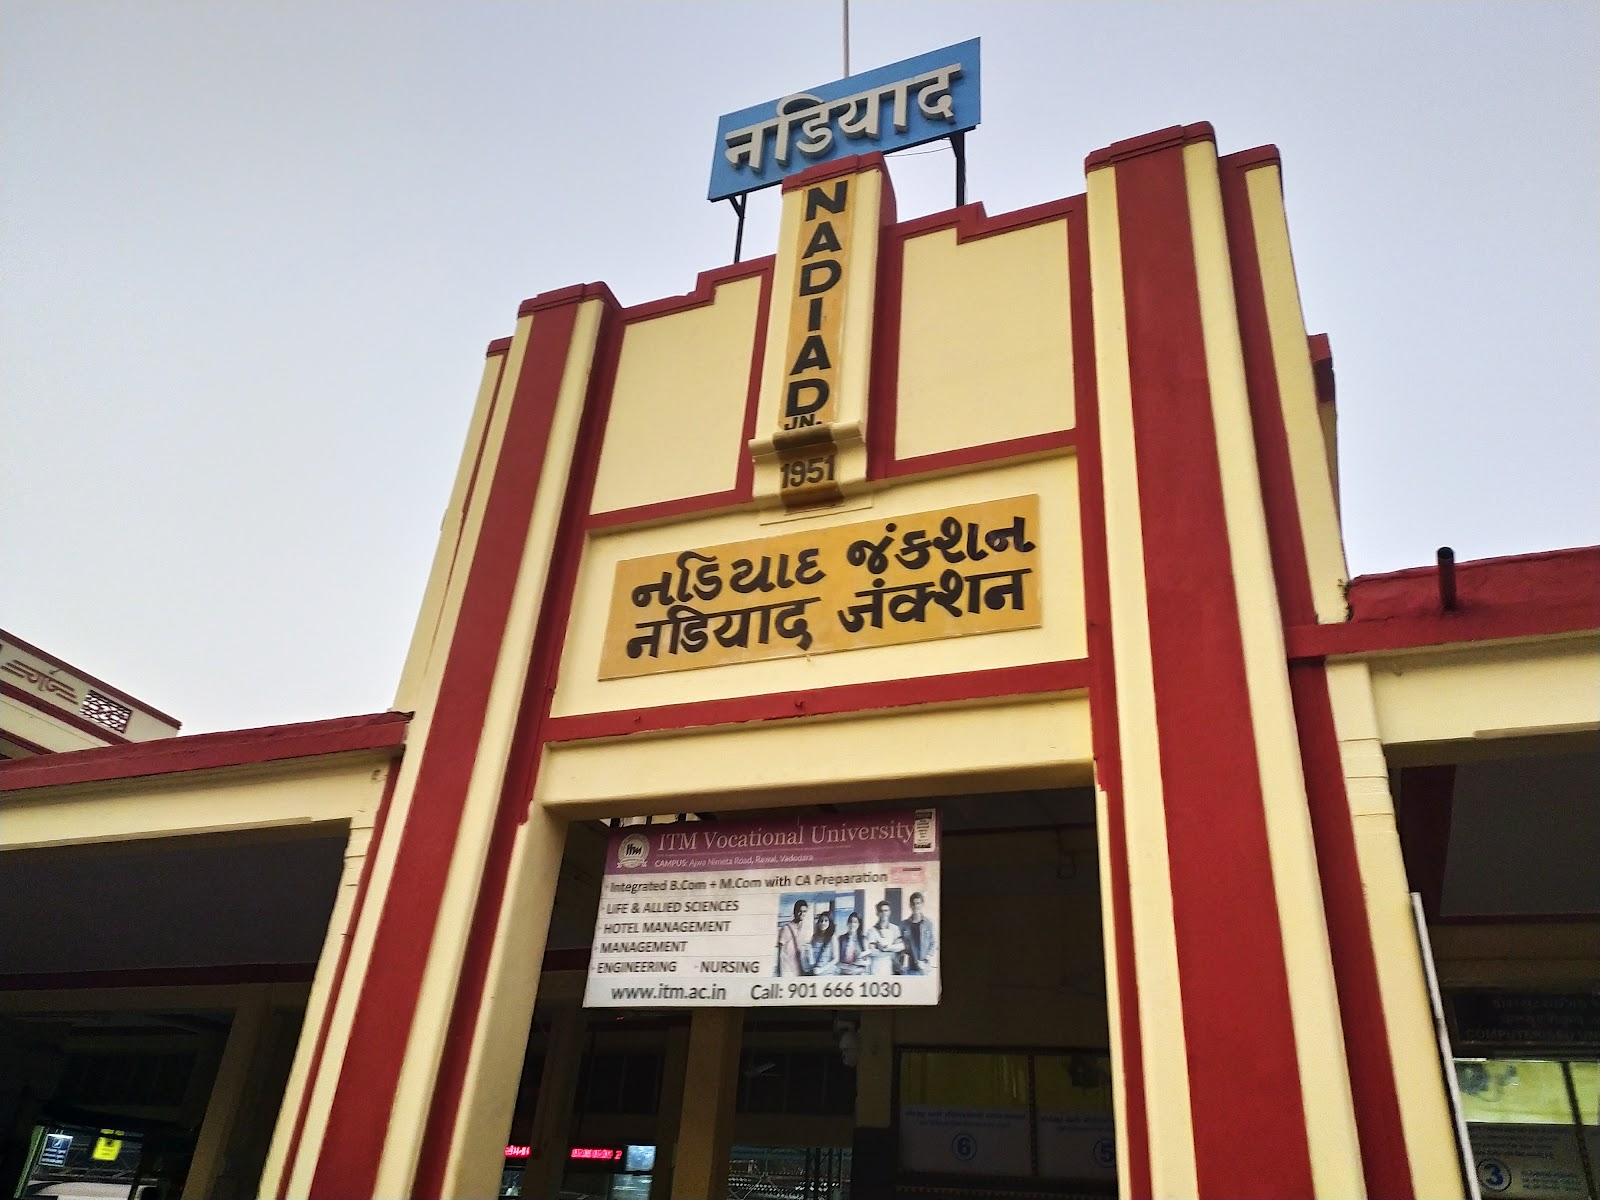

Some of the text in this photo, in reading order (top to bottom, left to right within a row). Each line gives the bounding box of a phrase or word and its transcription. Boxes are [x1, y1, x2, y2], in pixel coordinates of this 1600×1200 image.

[725, 62, 961, 172] नडियाद
[784, 180, 848, 417] NADIAD
[784, 413, 822, 430] JN.
[780, 454, 835, 488] 1951
[631, 515, 1037, 607] નડિયાદ જંકશન
[626, 567, 1034, 659] नडियाद जंक्शन
[657, 831, 699, 851] ITM
[702, 824, 804, 849] Vocational
[811, 819, 916, 845] University
[654, 857, 688, 868] CAMPUS:
[610, 880, 668, 894] Integrated
[669, 879, 707, 891] B.Com
[719, 877, 762, 890] M.Com
[764, 875, 791, 887] with
[795, 875, 811, 886] CA
[815, 871, 888, 886] Preparation
[606, 900, 740, 914] LIFE & ALLIED SCIENCES
[603, 920, 732, 934] HOTEL MANAGEMENT
[599, 940, 688, 954] MANAGEMENT
[597, 960, 760, 974] ENGINEERING NURSING
[611, 981, 901, 1000] www.itm.ac.in Call: 901 666 1030
[956, 1136, 972, 1155] 6
[1483, 1163, 1504, 1185] 3
